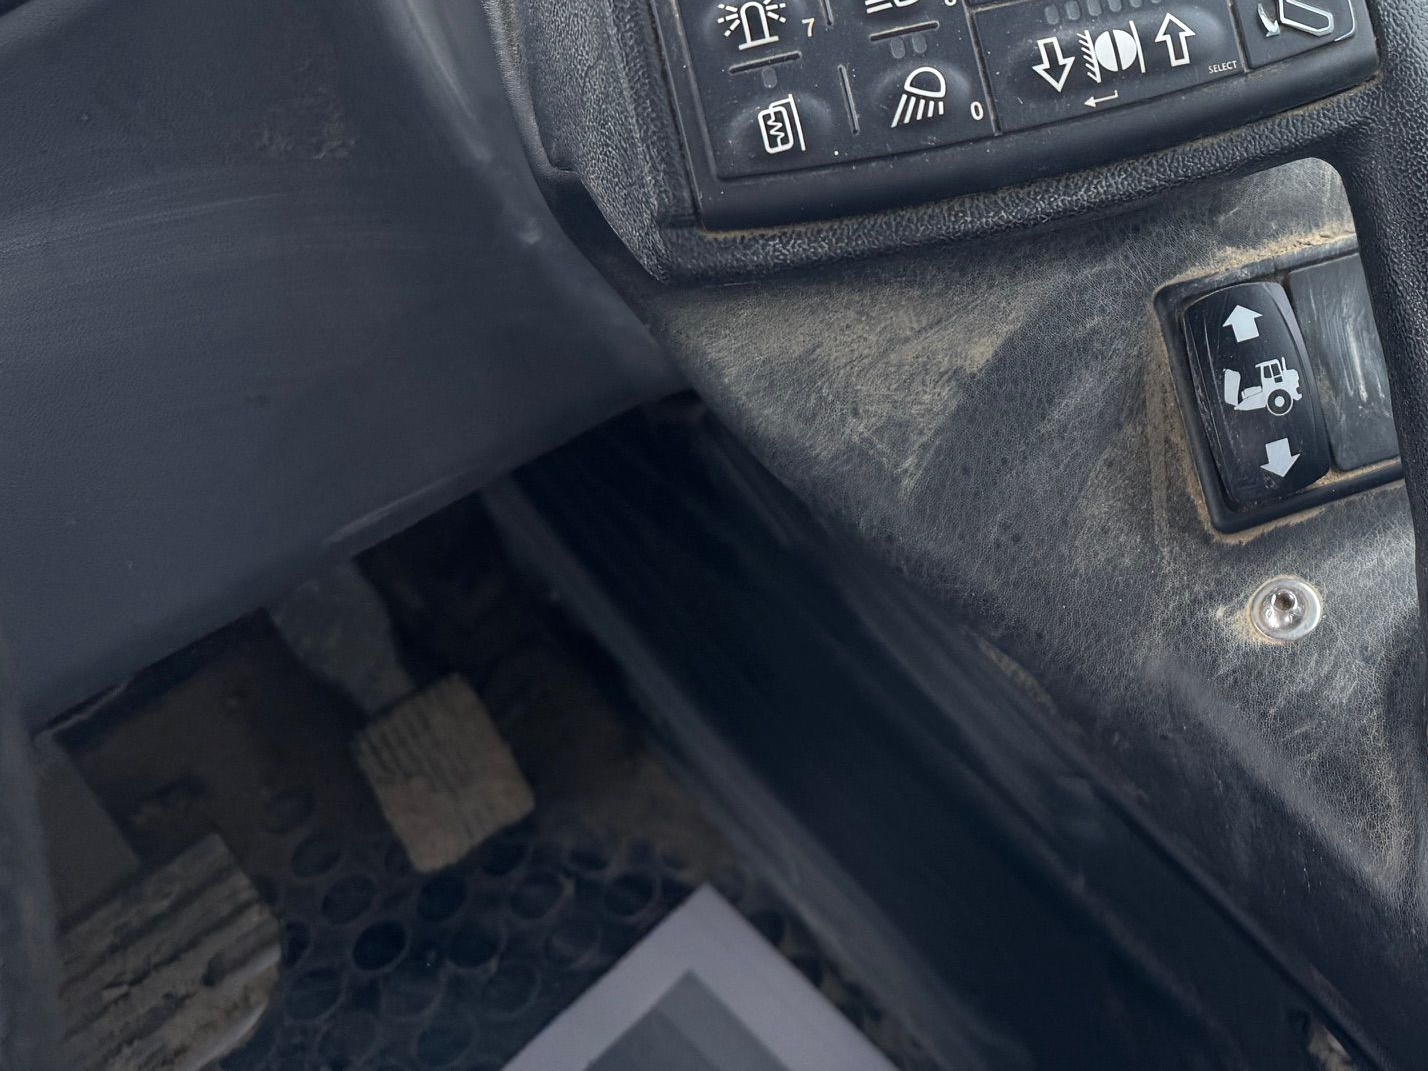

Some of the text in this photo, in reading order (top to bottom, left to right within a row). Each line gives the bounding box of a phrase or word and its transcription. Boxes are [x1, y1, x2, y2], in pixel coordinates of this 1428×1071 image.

[801, 17, 815, 38] 7
[1208, 60, 1238, 75] SELECT
[970, 100, 984, 121] 0
